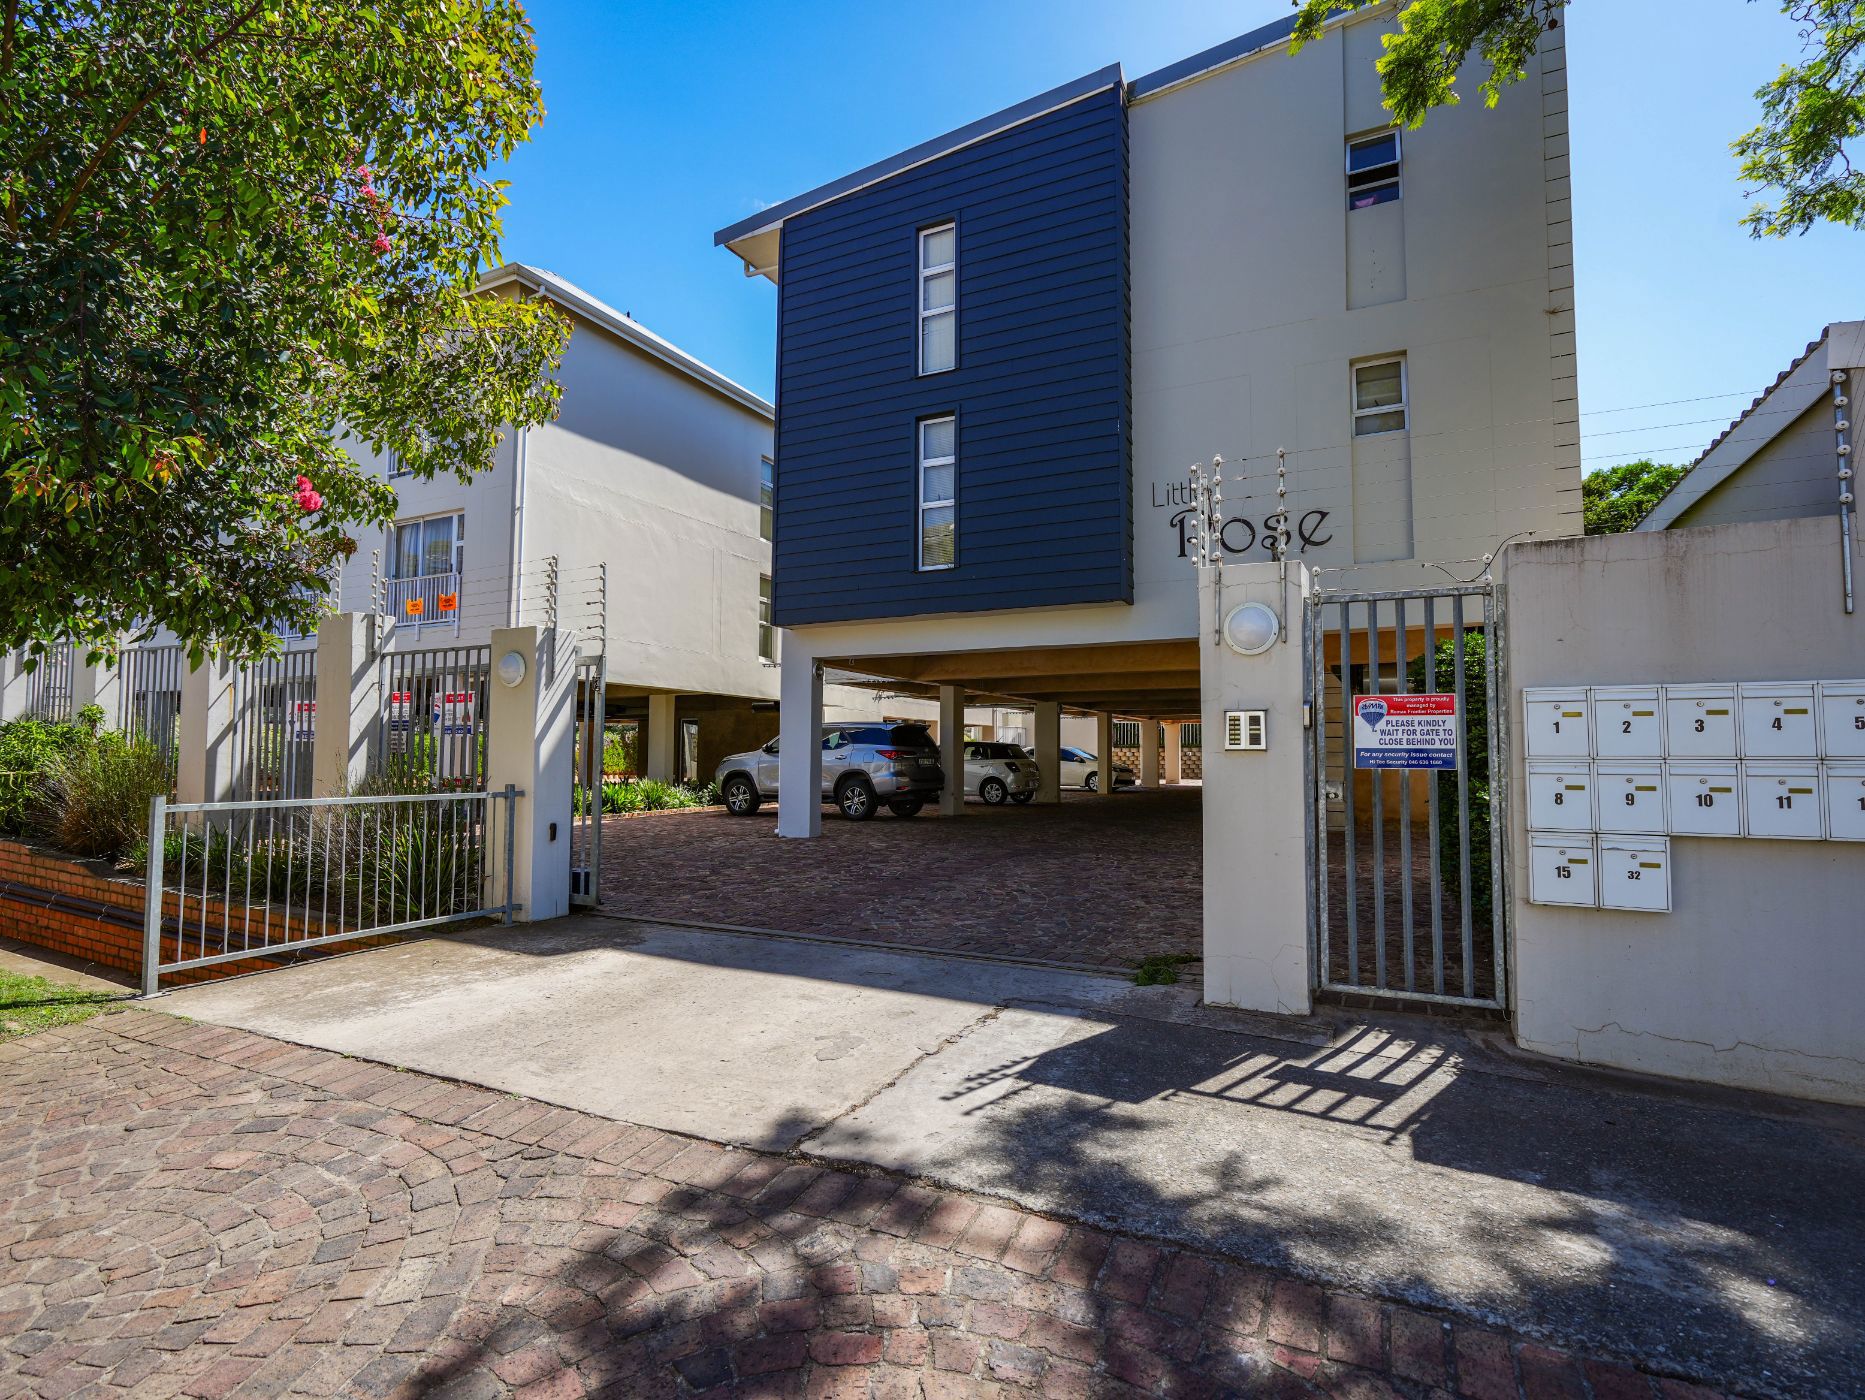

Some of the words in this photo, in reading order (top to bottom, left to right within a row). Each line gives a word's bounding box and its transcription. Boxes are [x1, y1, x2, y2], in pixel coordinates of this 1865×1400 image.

[1385, 719, 1415, 728] PLEASE
[1417, 719, 1447, 728] KINDLY
[1553, 721, 1560, 734] 1
[1622, 720, 1632, 734] 2
[1694, 718, 1705, 733] 3
[1772, 717, 1783, 731] 4
[1854, 716, 1865, 730] 5
[1379, 728, 1399, 737] WAIT
[1402, 728, 1417, 737] FOR
[1419, 728, 1440, 737] GATE
[1442, 728, 1453, 737] TO
[1378, 737, 1404, 746] CLOSE
[1406, 737, 1436, 746] BEHIND
[1438, 737, 1455, 746] YOU
[1554, 792, 1563, 806] 8
[1625, 792, 1635, 806] 9
[1695, 793, 1714, 808] 10
[1776, 795, 1792, 809] 11
[1555, 865, 1571, 879] 15
[1627, 870, 1641, 881] 32
